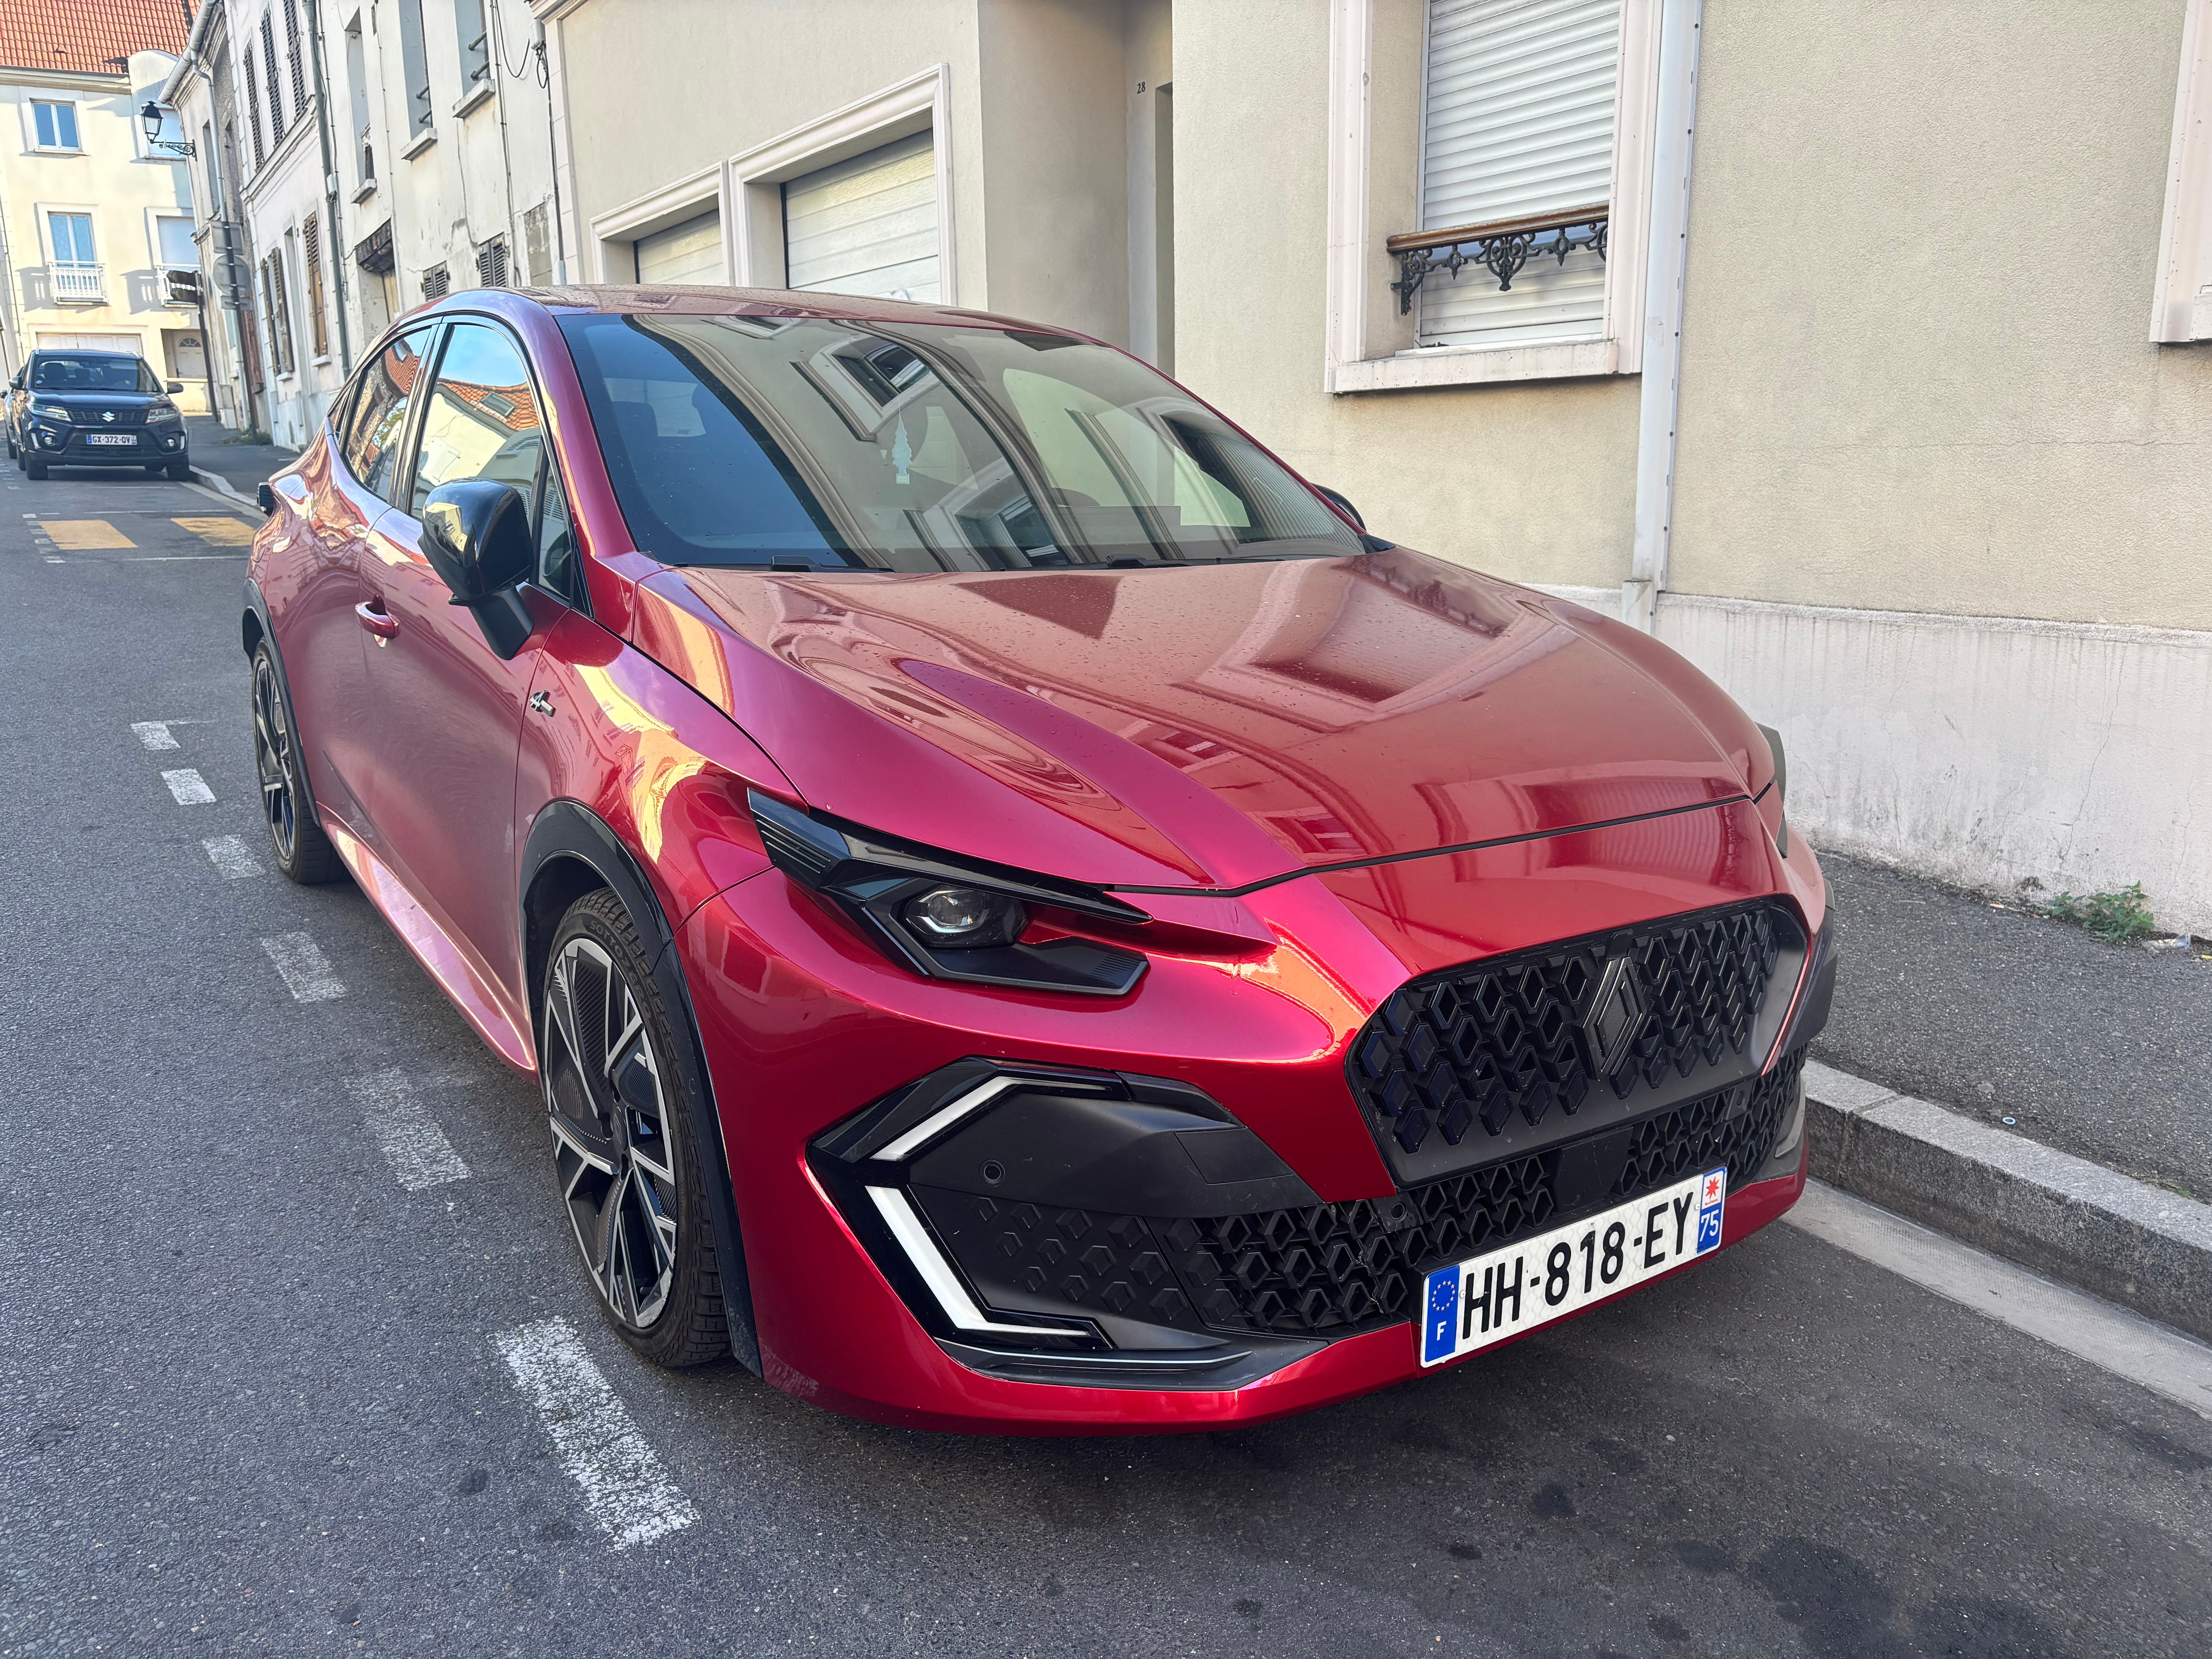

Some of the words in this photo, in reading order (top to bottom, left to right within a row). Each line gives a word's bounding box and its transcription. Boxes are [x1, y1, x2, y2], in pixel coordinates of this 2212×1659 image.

[1137, 81, 1146, 94] 28
[590, 921, 651, 1019] SOTTOZERO
[1700, 1209, 1719, 1242] 75
[1462, 1192, 1694, 1340] HH-818-EY
[1437, 1321, 1446, 1341] F
